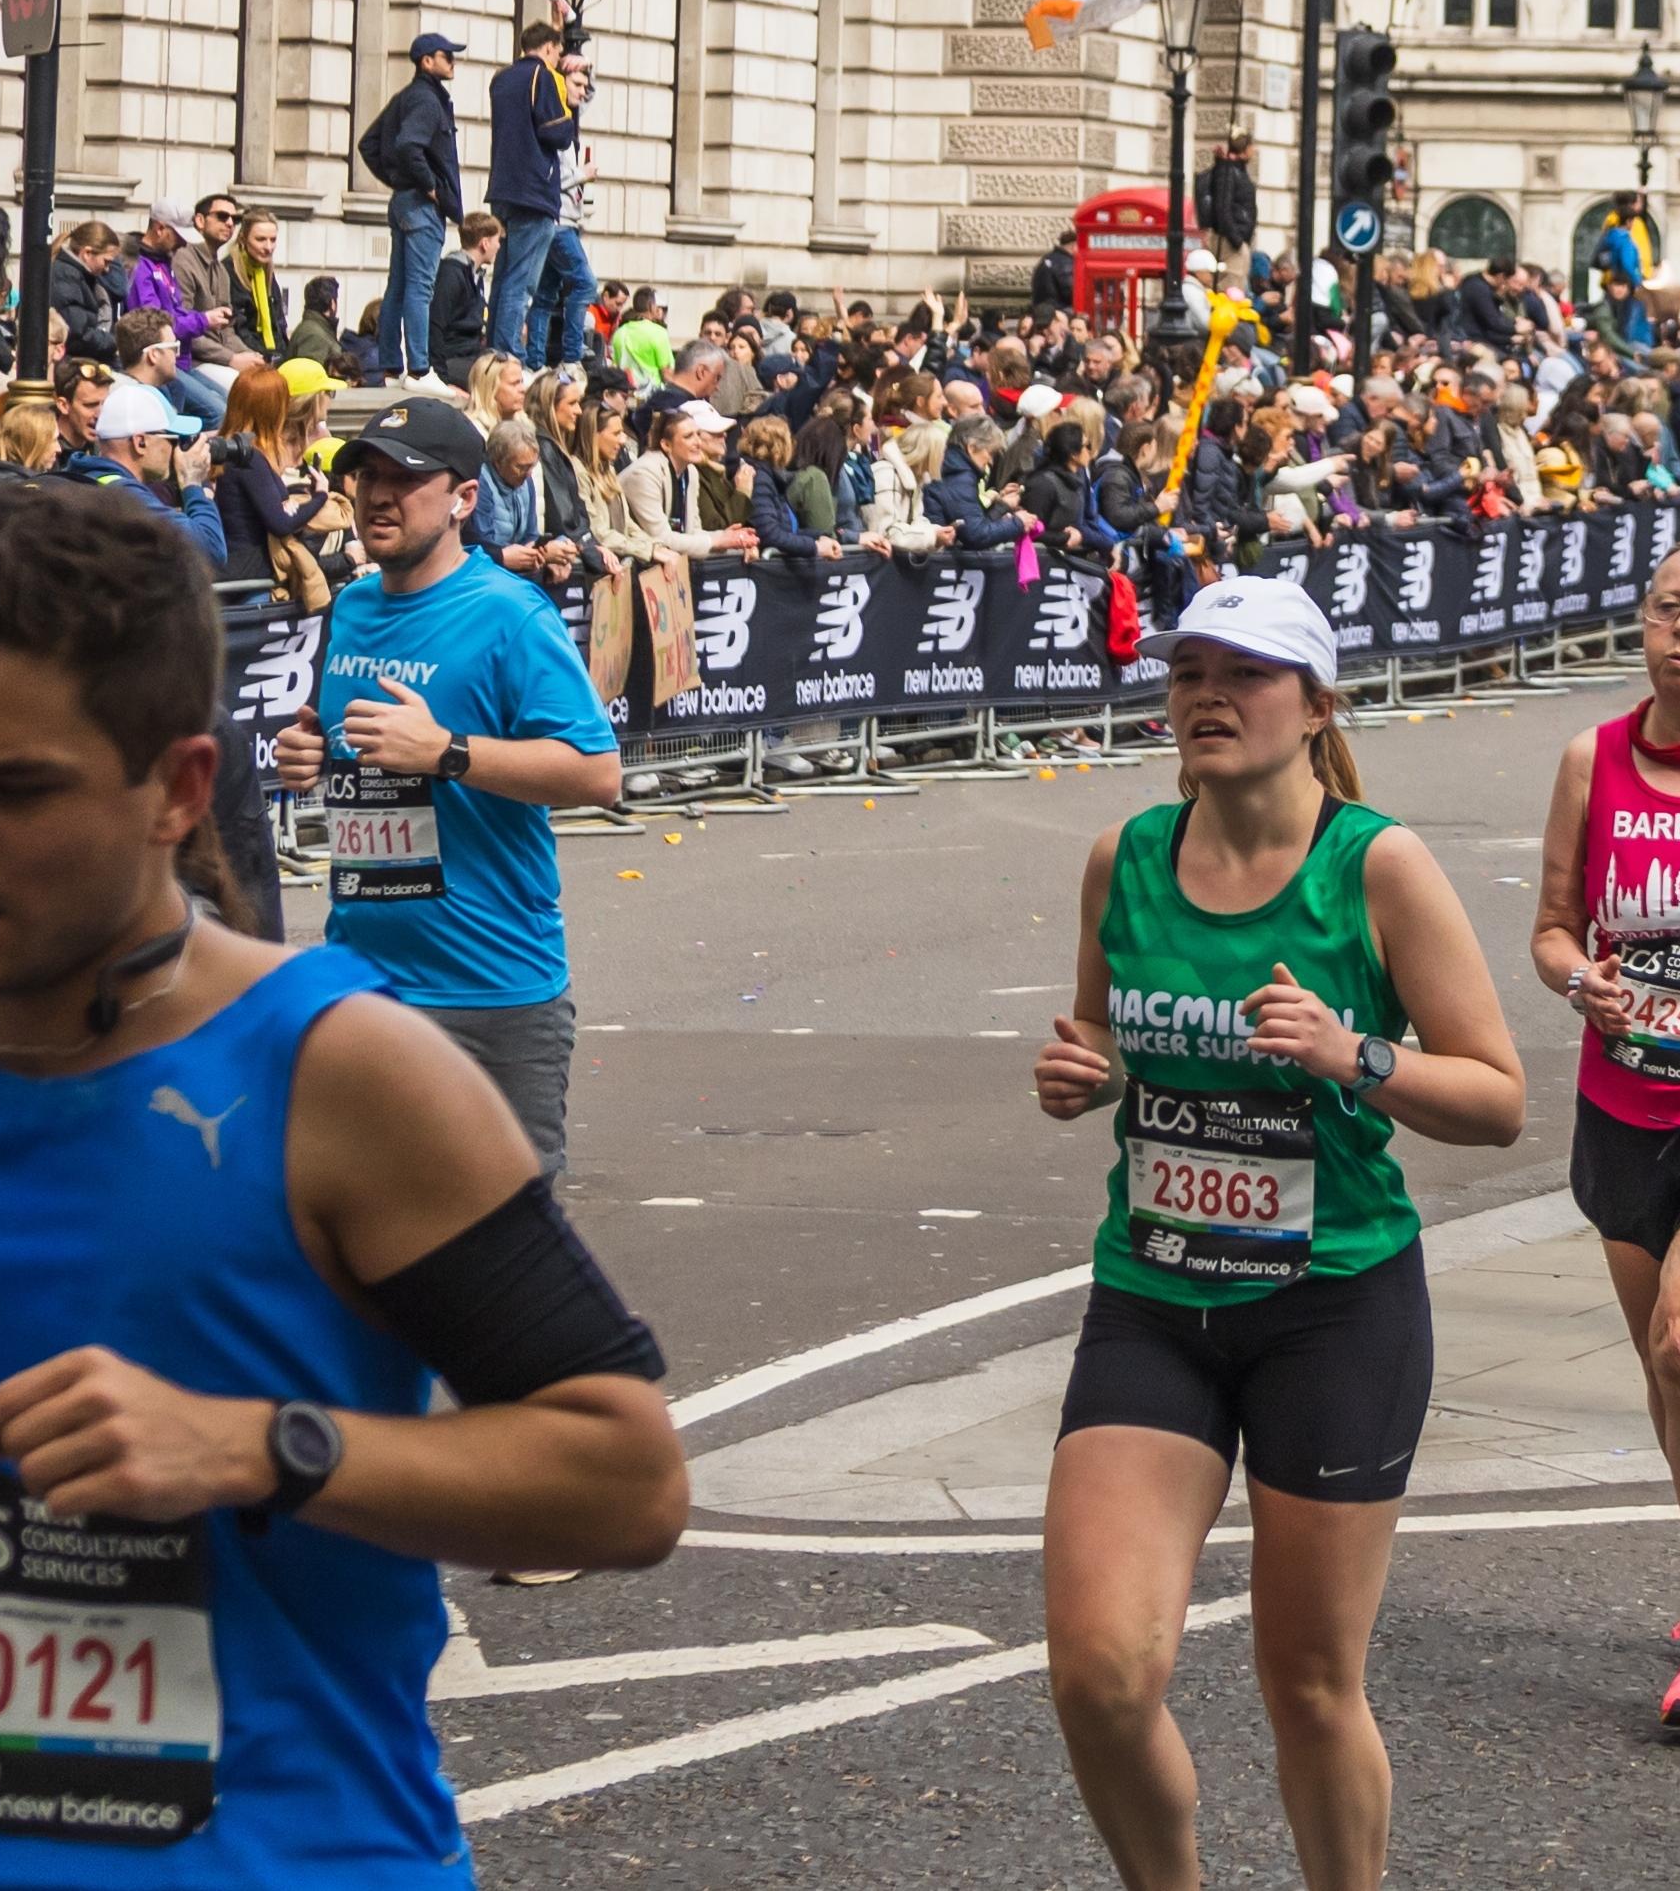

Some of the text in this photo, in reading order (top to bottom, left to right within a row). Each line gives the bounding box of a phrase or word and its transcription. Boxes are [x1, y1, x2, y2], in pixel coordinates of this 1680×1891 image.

[327, 654, 439, 686] ANTHONY
[904, 661, 984, 694] new balance
[1014, 658, 1102, 689] new balance
[667, 681, 767, 717] new balance
[795, 670, 876, 706] new balance
[359, 777, 423, 789] CONSULTANCY
[360, 767, 383, 777] TATA
[359, 789, 400, 801] SERVICES
[335, 817, 412, 855] 26111
[337, 872, 361, 896] NB
[361, 882, 432, 896] new balance
[1114, 1030, 1189, 1057] ANCER
[1642, 1062, 1667, 1075] new
[1136, 1083, 1198, 1135] tcs
[1200, 1100, 1241, 1115] TATA
[1205, 1113, 1300, 1133] CONSULTANCY
[1203, 1125, 1264, 1146] SERVICES
[1152, 1159, 1281, 1222] 23863
[1143, 1228, 1187, 1264] NB
[1186, 1256, 1292, 1276] new balance
[19, 1496, 86, 1530] TA
[19, 1526, 190, 1559] CONSULTANCY
[20, 1556, 129, 1587] SERVICES
[59, 1790, 183, 1831] balance
